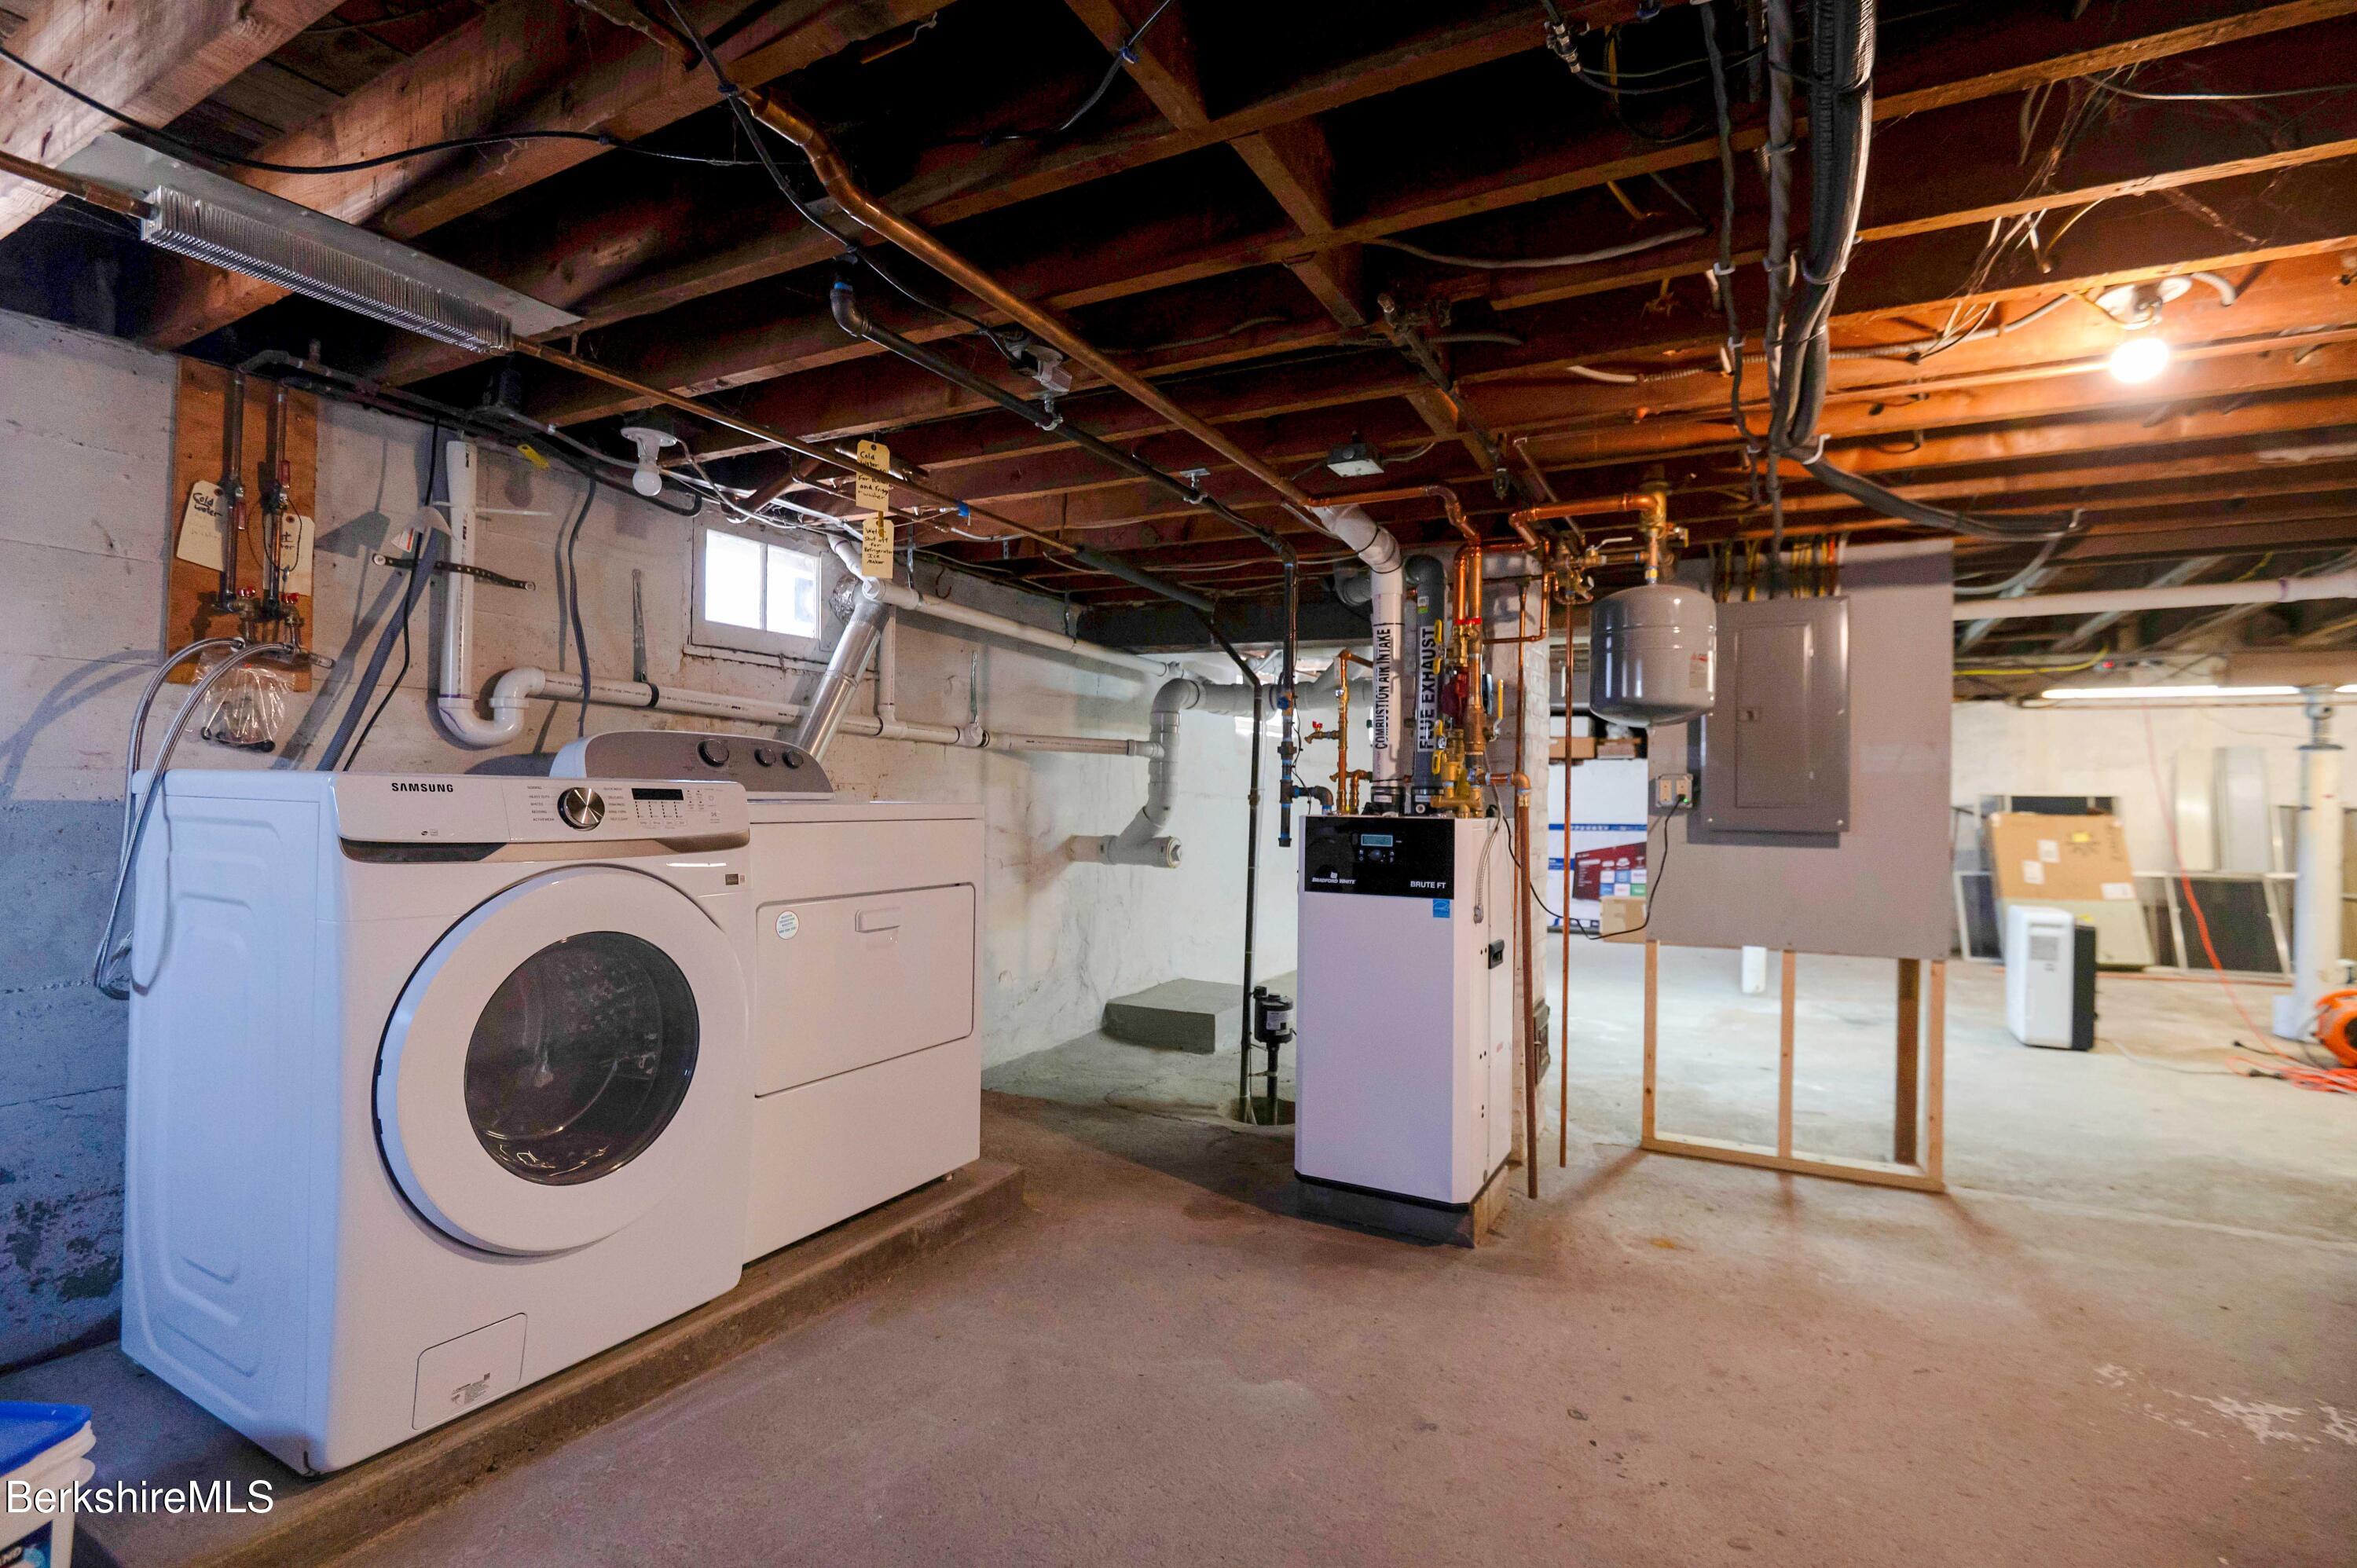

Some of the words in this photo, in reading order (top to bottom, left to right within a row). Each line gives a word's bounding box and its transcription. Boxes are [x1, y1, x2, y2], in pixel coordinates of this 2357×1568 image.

[860, 451, 875, 460] Cold
[192, 492, 214, 506] Cold
[1376, 628, 1391, 664] INTAKE
[1378, 667, 1390, 683] AIR
[1420, 628, 1436, 703] EXHAUST
[1375, 686, 1390, 749] COMBUSTION
[1419, 709, 1435, 749] FLUE
[391, 782, 453, 793] SAMSUNG
